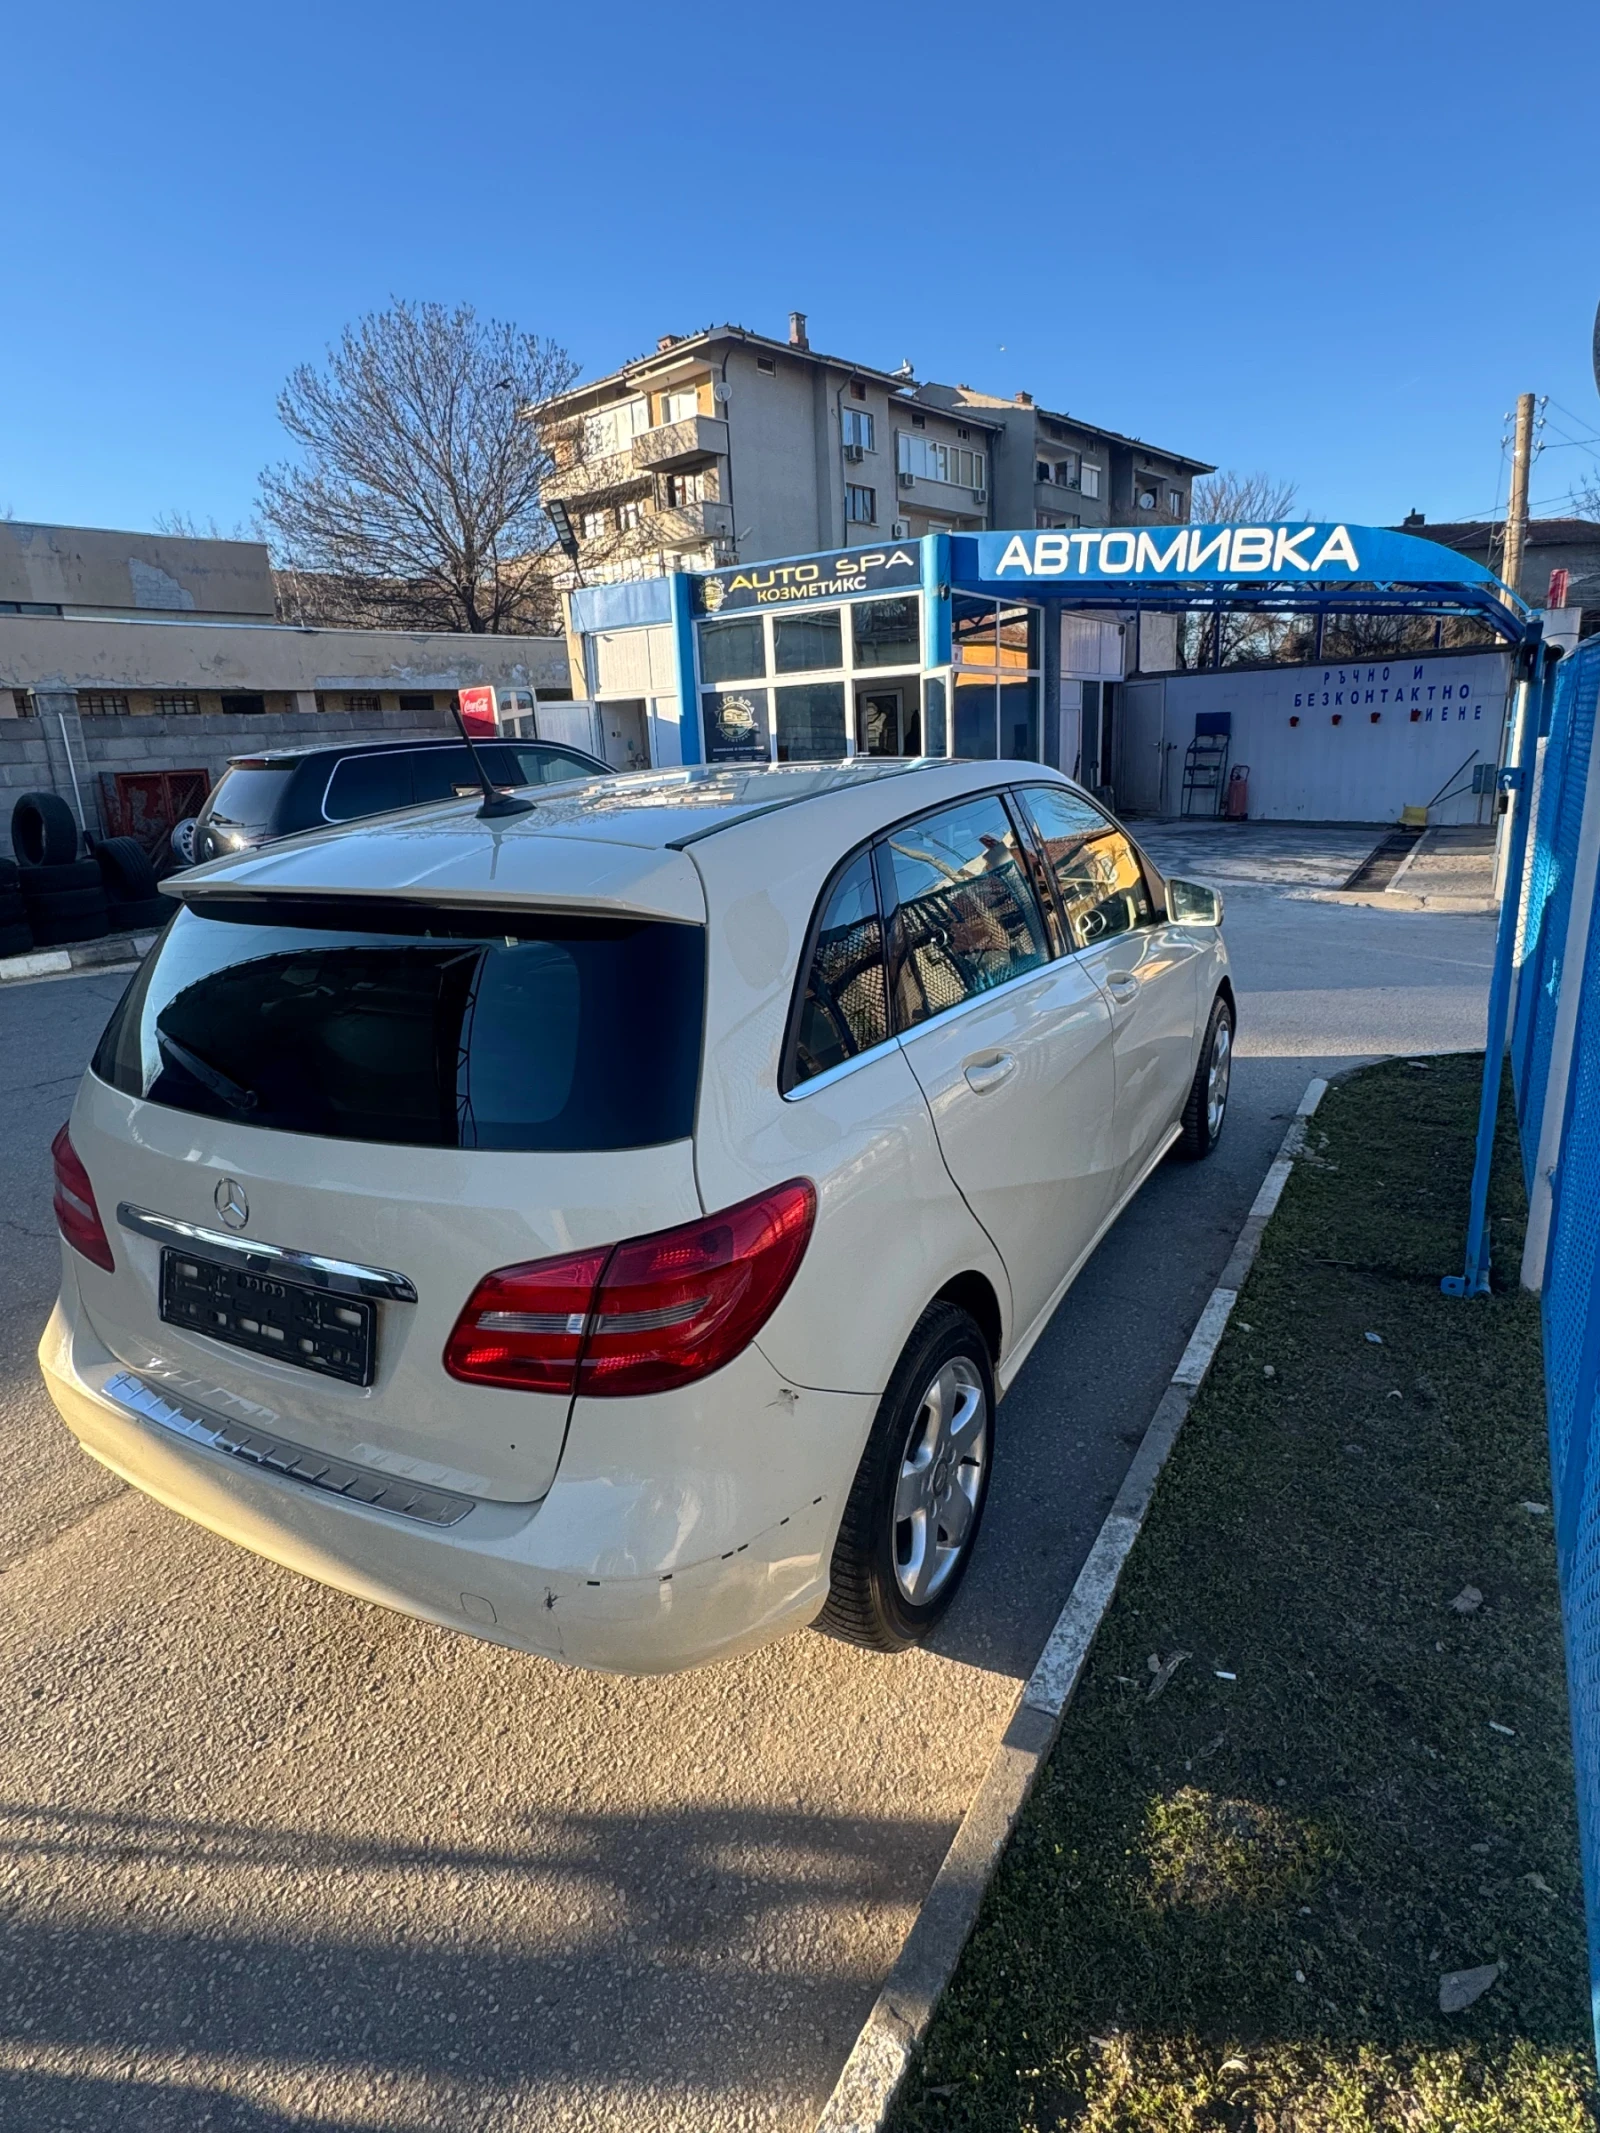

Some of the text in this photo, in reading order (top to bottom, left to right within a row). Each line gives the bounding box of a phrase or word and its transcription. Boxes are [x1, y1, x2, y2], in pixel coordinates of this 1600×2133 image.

[996, 525, 1360, 576] АВТОМИВКА
[728, 550, 914, 593] AUTO SPA
[757, 576, 867, 603] КОЗМЕТИКС
[1324, 665, 1424, 686] РЪЧНО И
[1294, 684, 1470, 708] БЕЗКОНТАКТНО
[1411, 705, 1482, 723] ИЕНЕ
